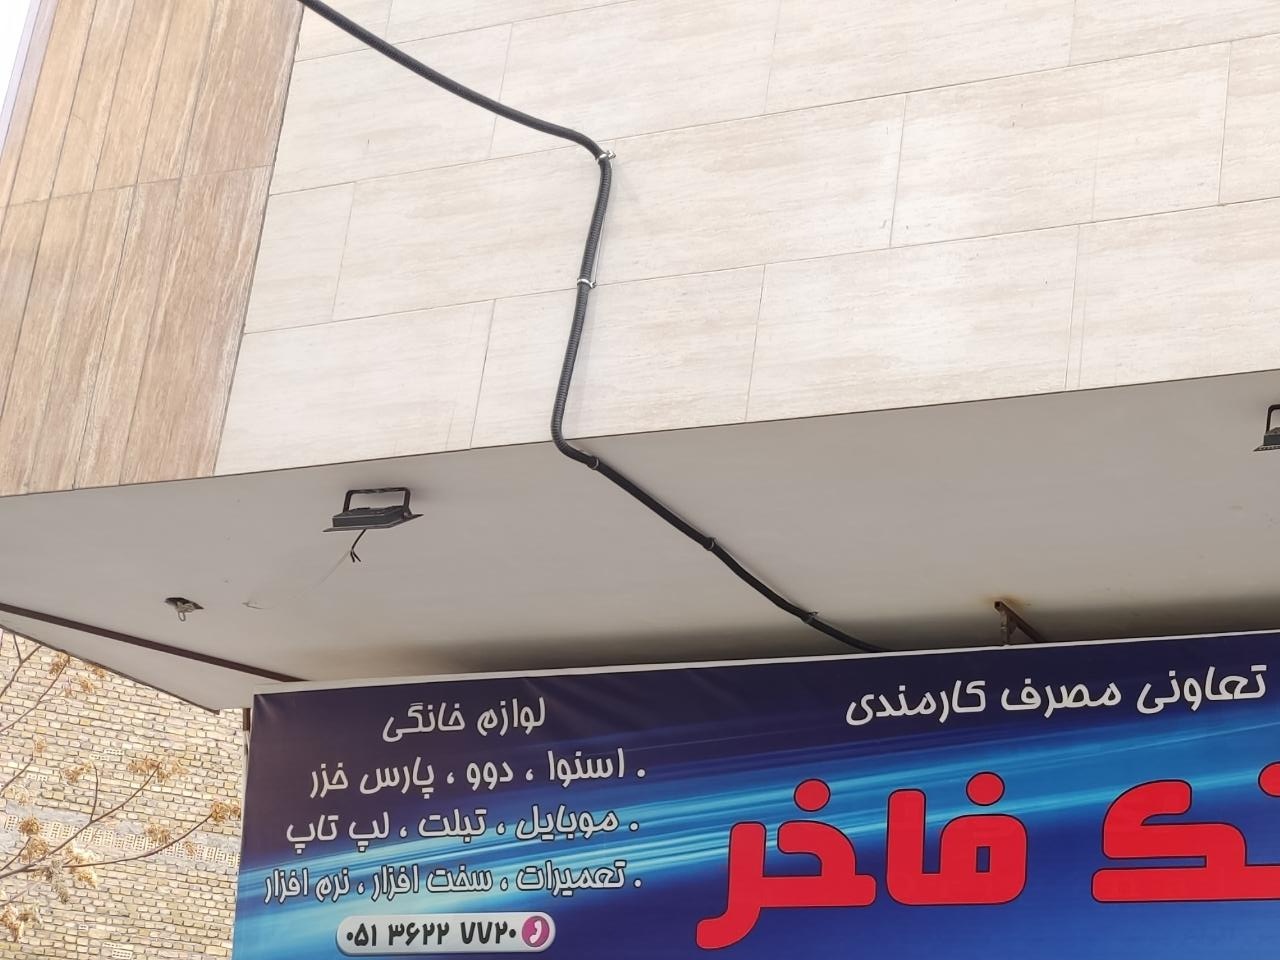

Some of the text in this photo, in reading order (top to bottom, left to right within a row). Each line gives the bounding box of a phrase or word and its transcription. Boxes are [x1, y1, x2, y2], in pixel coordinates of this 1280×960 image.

[846, 664, 1267, 726] تعاونی مصرف کارمندی
[383, 697, 545, 742] لوازم خانگی
[310, 762, 349, 798] خزر
[360, 756, 435, 799] پارس
[466, 761, 514, 791] دوو
[548, 747, 624, 788] اسنوا
[286, 814, 339, 855] تاپ
[348, 811, 390, 853] لپ
[417, 808, 488, 844] تبلت
[515, 804, 619, 841] موبایل
[425, 864, 494, 893] سخت
[516, 859, 628, 897] تعمیرات
[696, 771, 1029, 950] فاخر
[263, 866, 309, 905] افزار
[315, 866, 351, 902] نرم
[370, 863, 420, 902] افزار
[346, 920, 516, 946] ۰۵۱ ۳۶۲۲ ۷۷۲۰
